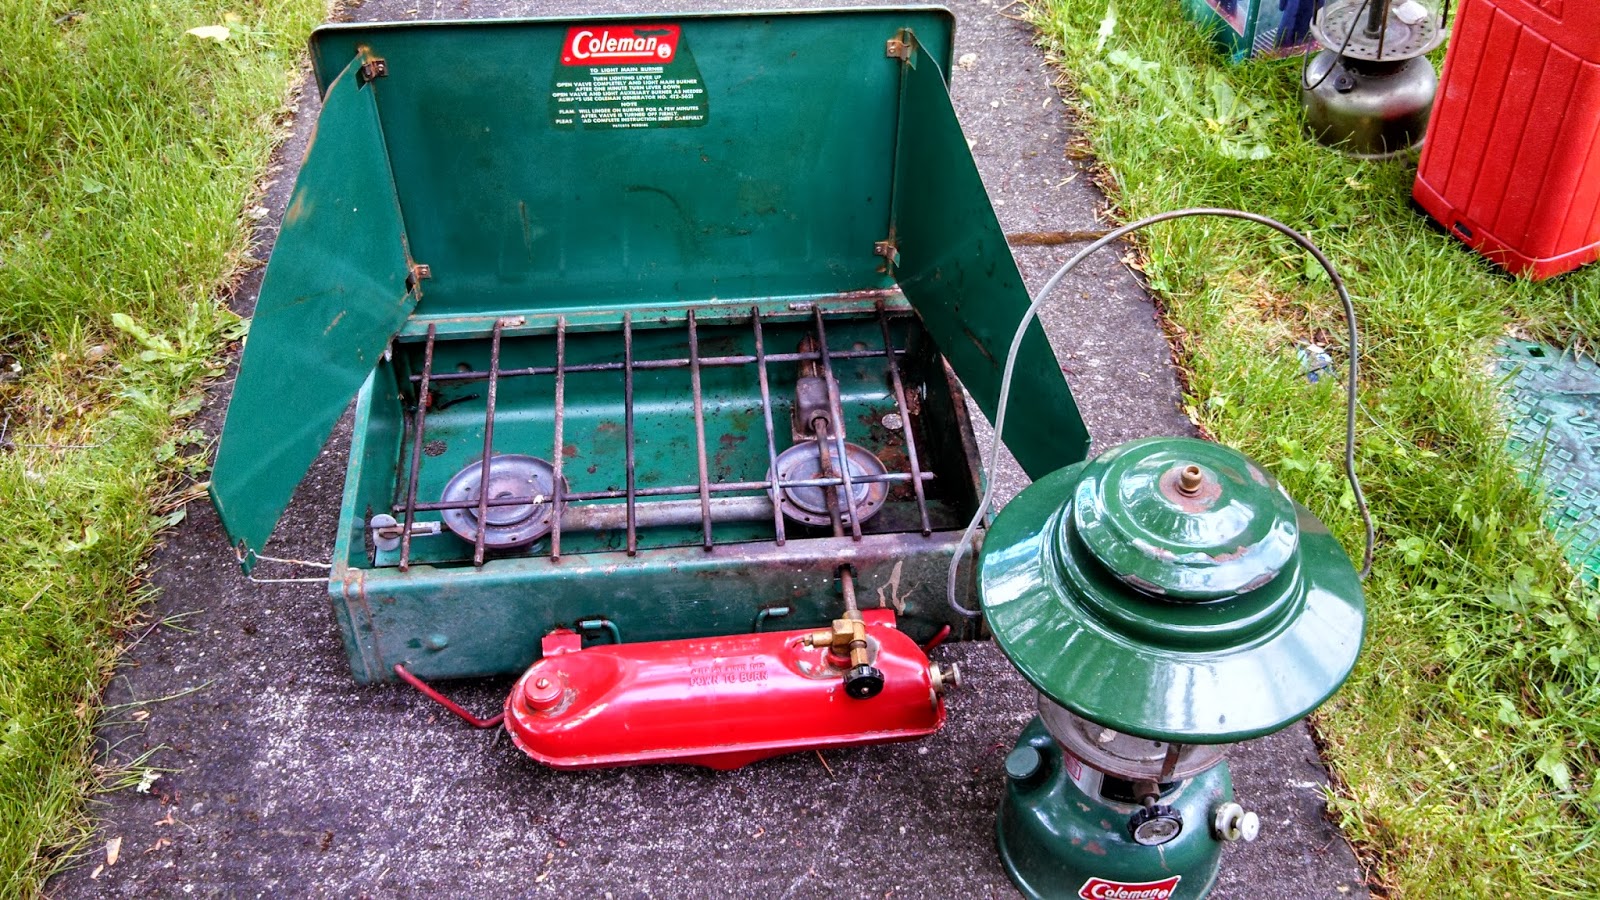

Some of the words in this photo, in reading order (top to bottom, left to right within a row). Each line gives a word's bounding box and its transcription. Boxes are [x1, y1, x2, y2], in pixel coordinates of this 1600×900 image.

[572, 30, 657, 59] Coleman
[689, 675, 718, 687] DOWN
[723, 672, 737, 683] TO
[740, 671, 768, 682] BURN
[1091, 884, 1159, 900] Coleman
